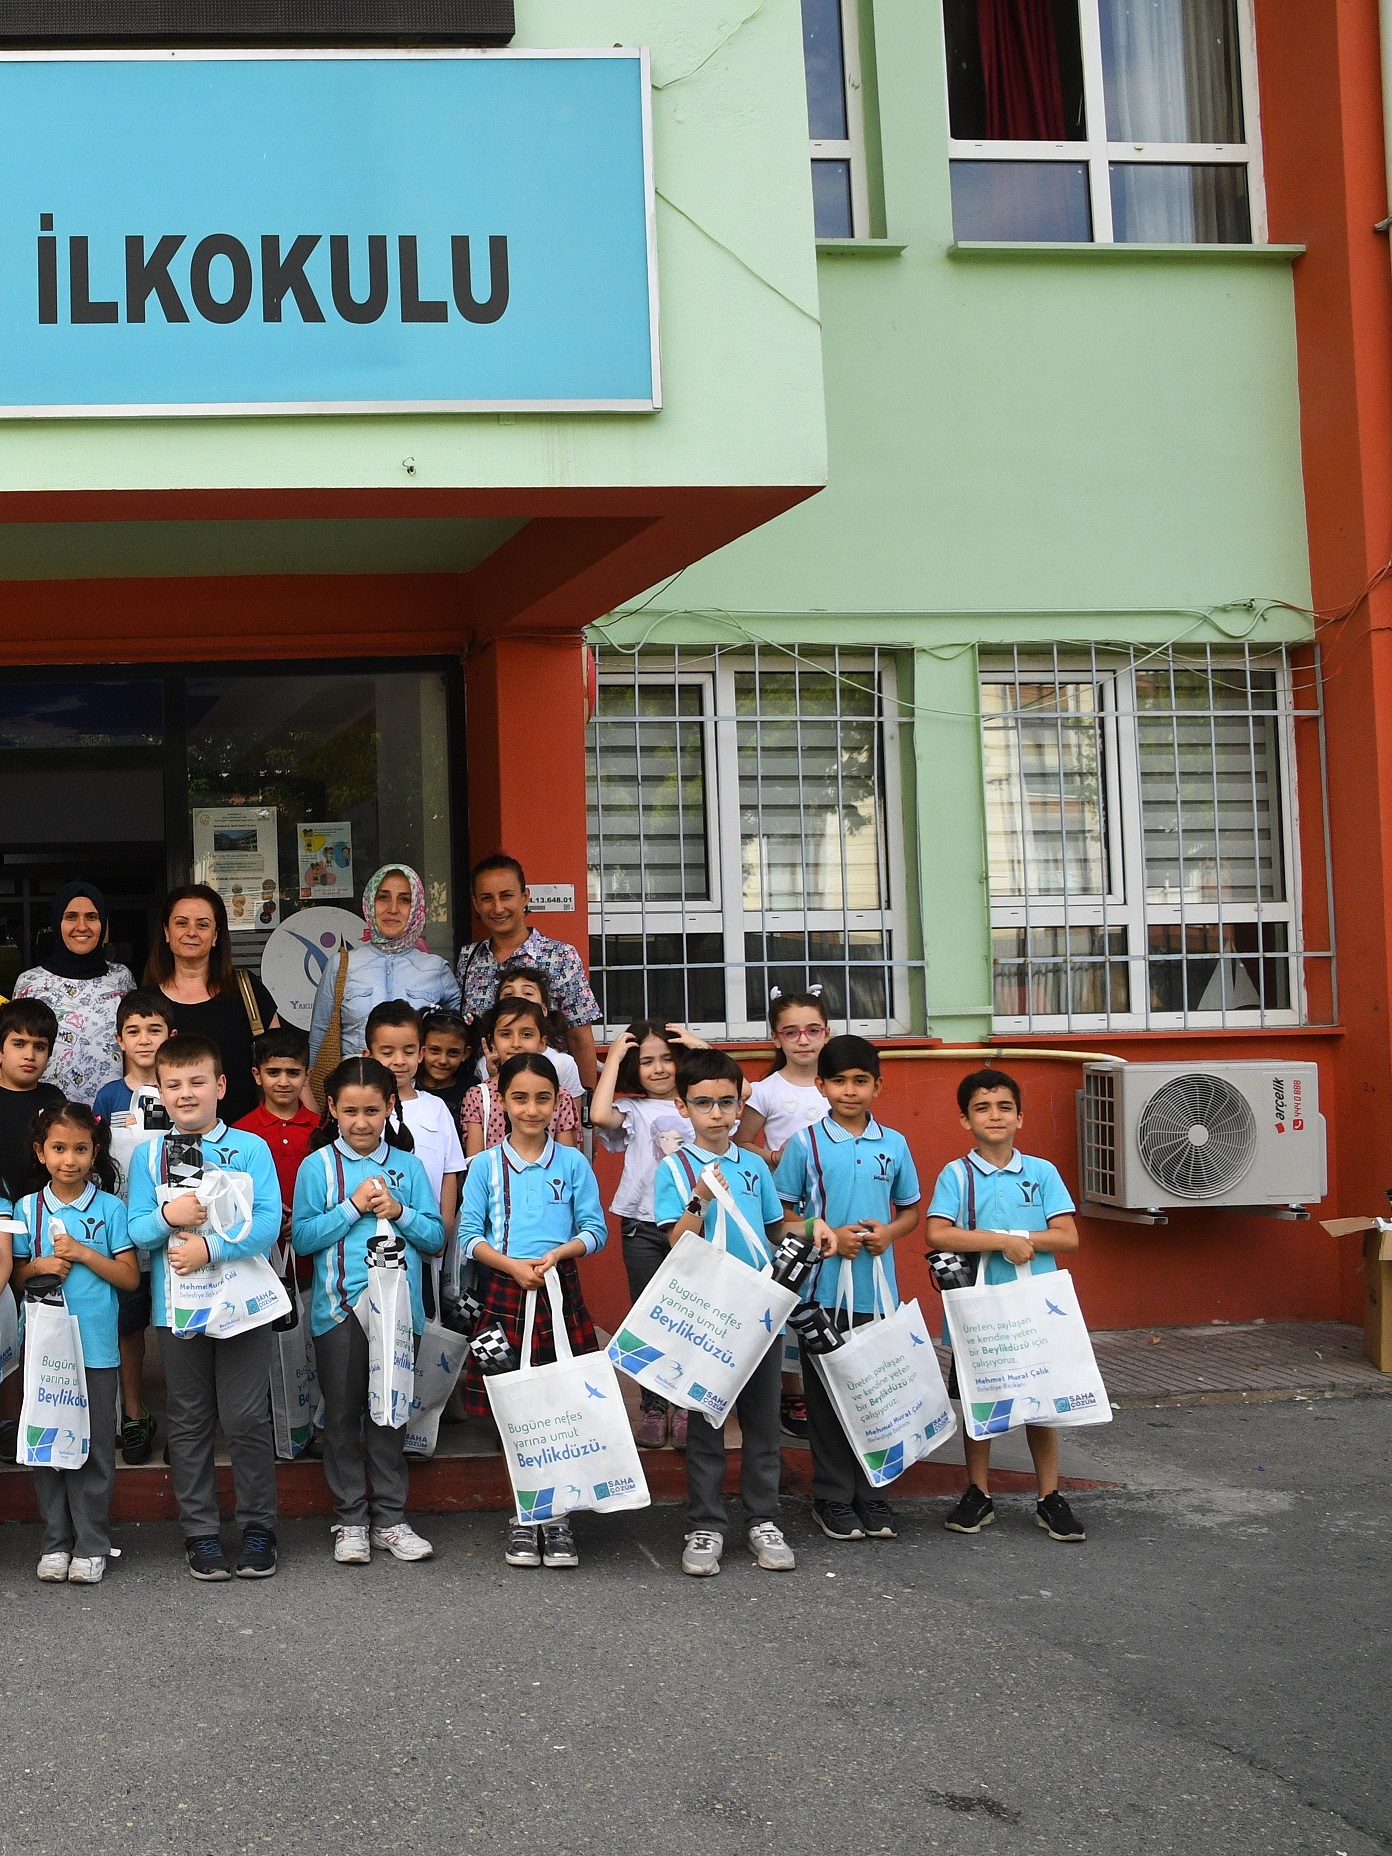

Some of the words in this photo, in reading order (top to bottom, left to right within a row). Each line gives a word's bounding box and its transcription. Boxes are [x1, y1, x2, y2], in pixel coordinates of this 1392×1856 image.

[37, 212, 510, 325] İLKOKULU
[1273, 1077, 1287, 1120] arçelik
[255, 1289, 274, 1302] SAHA
[668, 1279, 711, 1310] Bugüne
[712, 1308, 743, 1330] nefes
[660, 1294, 695, 1319] yarına
[696, 1315, 728, 1339] umut
[997, 1317, 1032, 1331] paylaşan
[966, 1337, 975, 1345] ve
[977, 1332, 1010, 1344] kendine
[1012, 1327, 1037, 1341] yeten
[968, 1347, 980, 1356] bir
[981, 1340, 1030, 1355] Beylikdüzü
[1032, 1337, 1049, 1348] için
[873, 1355, 906, 1377] paylaşan
[975, 1374, 1005, 1385] Mehmet
[1007, 1371, 1028, 1381] Murat
[1030, 1366, 1050, 1378] Çalık
[40, 1374, 70, 1385] yarına
[852, 1393, 863, 1401] ve
[864, 1376, 888, 1396] kendine
[888, 1365, 911, 1381] yeten
[855, 1404, 868, 1412] bir
[869, 1378, 908, 1407] Beylikdüzü
[1068, 1391, 1094, 1402] SAHA
[507, 1418, 551, 1435] Bugüne
[554, 1411, 583, 1425] nefes
[865, 1422, 894, 1437] Mehmet
[893, 1410, 912, 1423] Murat
[513, 1435, 547, 1451] yarına
[550, 1427, 579, 1442] umut
[608, 1477, 634, 1488] SAHA
